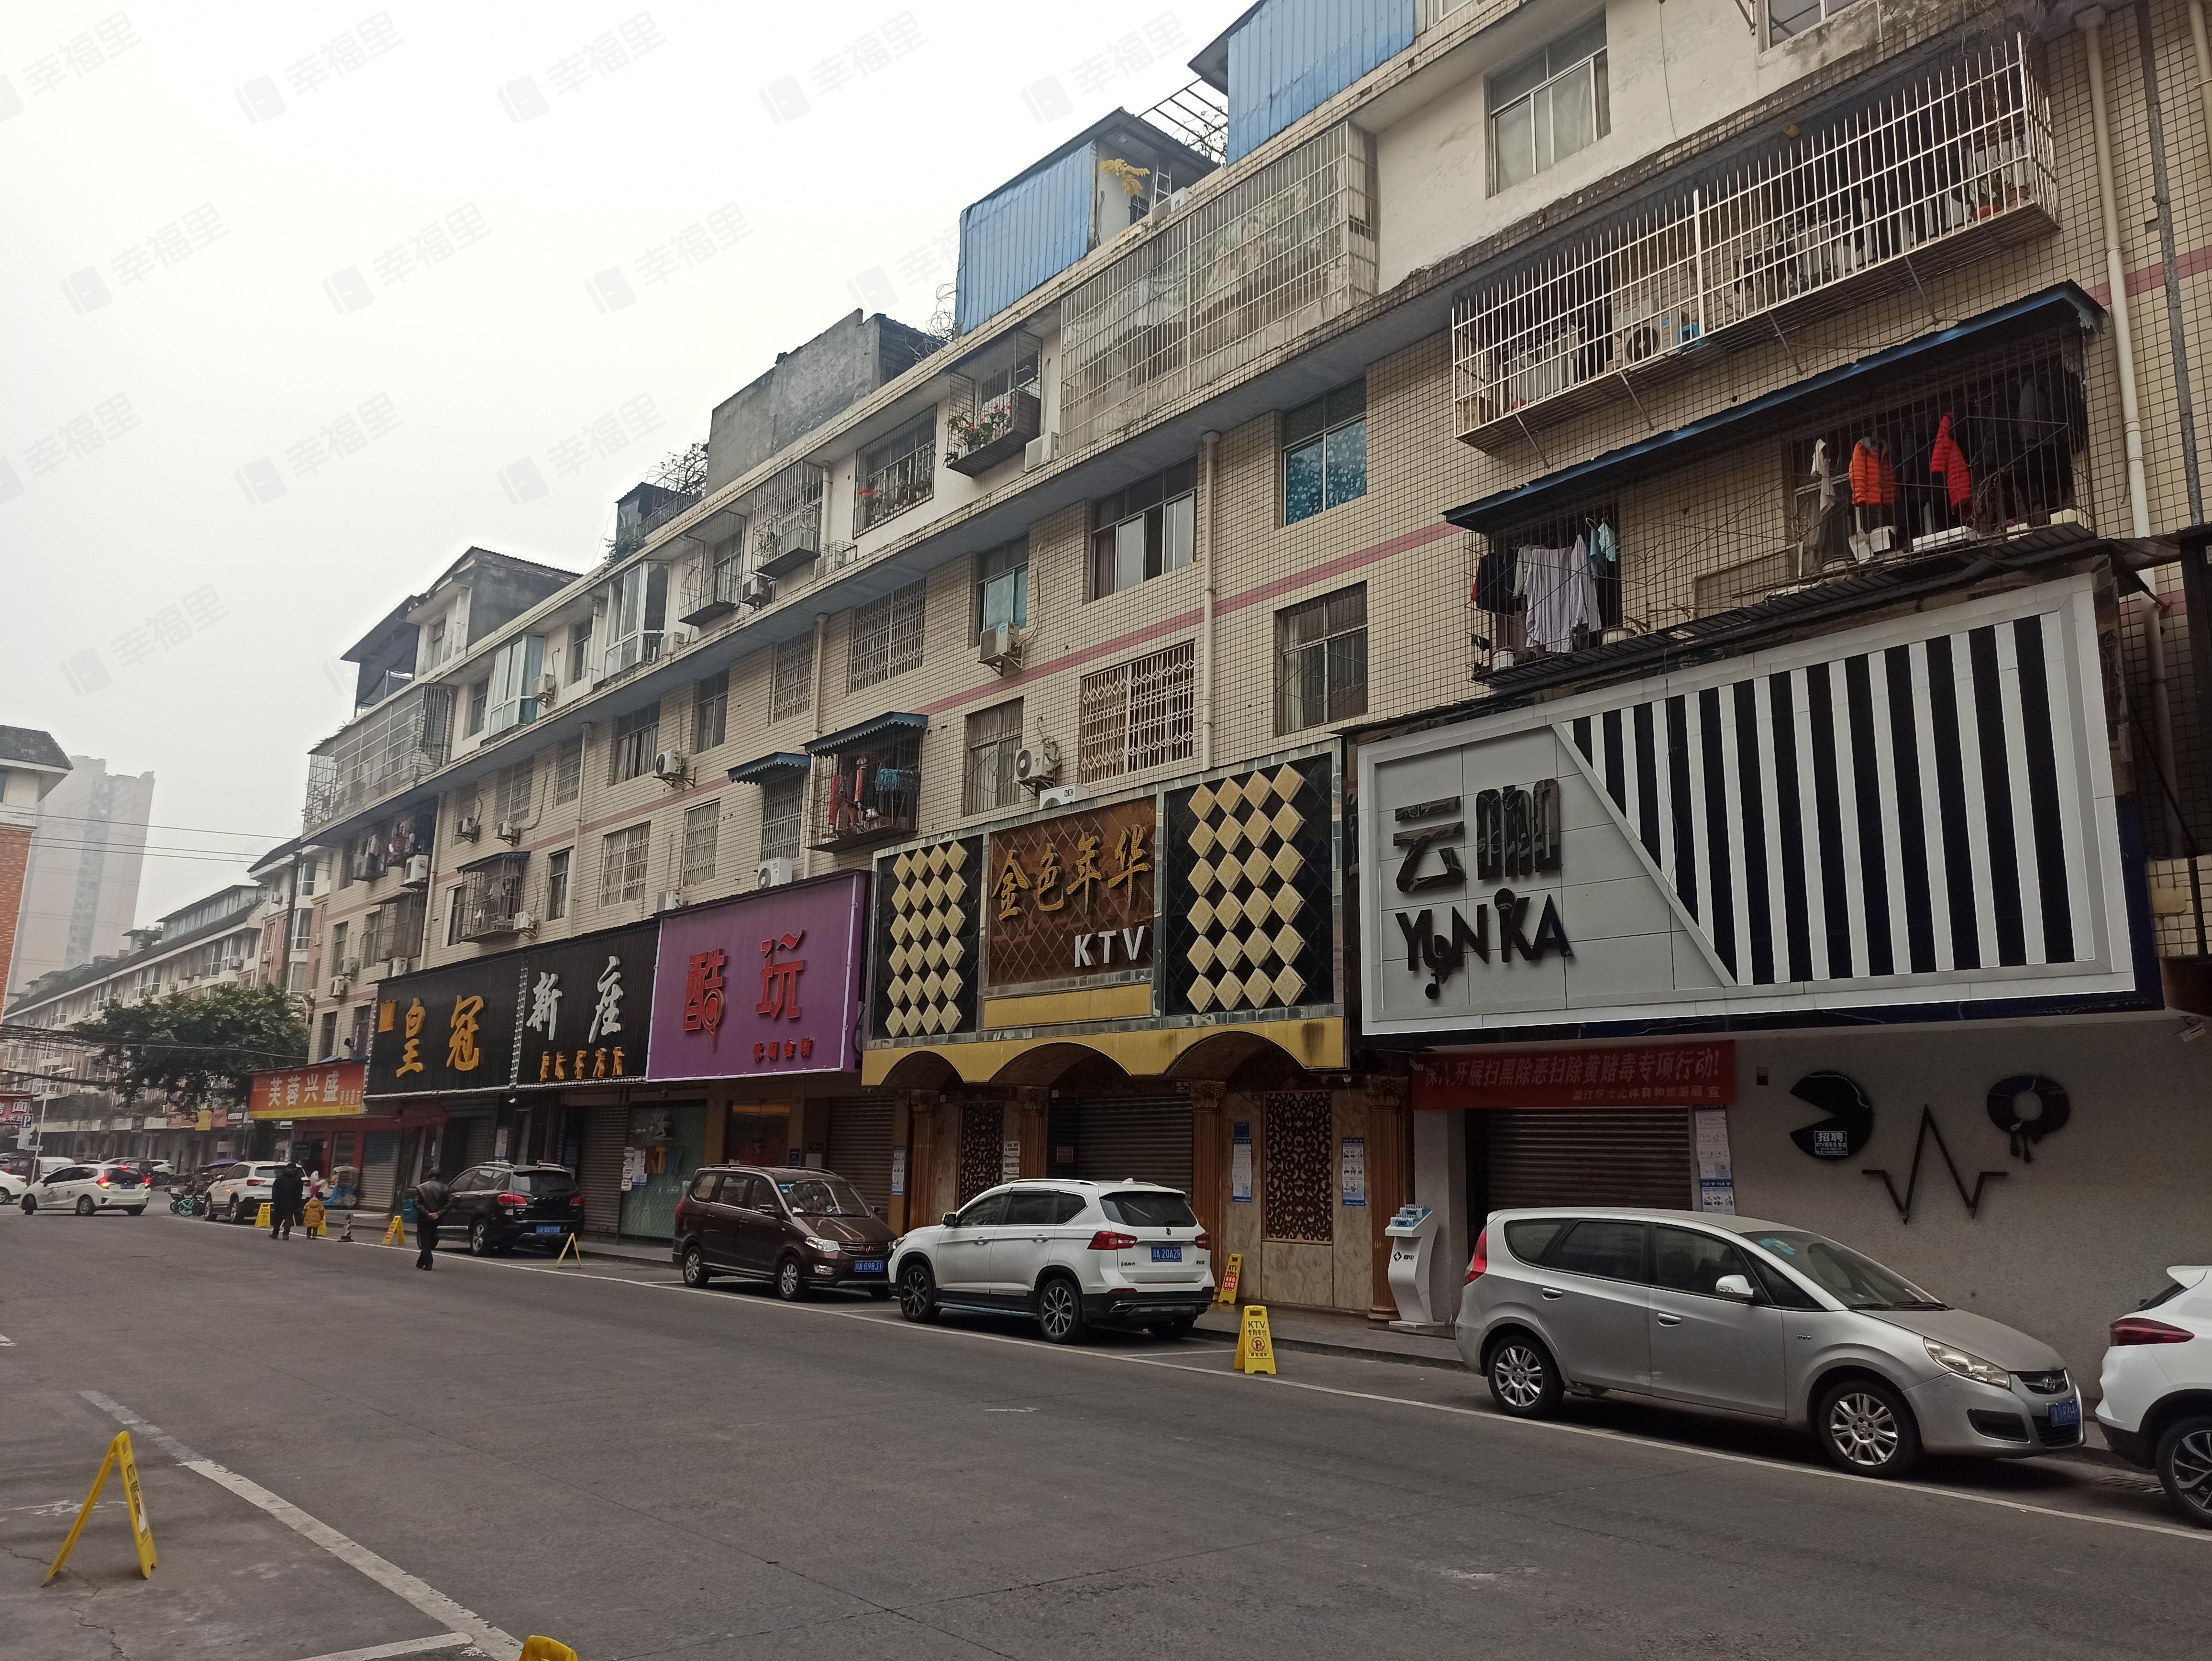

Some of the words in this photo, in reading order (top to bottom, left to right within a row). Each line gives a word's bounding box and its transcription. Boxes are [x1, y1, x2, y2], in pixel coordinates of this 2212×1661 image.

[992, 824, 1150, 921] 金色年华
[1074, 925, 1145, 968] KTV
[683, 930, 806, 1050] 酷玩
[396, 995, 484, 1078] 皇冠
[268, 1071, 339, 1107] 芙蓉兴盛
[1572, 1086, 1703, 1100] 温江区文化体育和旅游局
[1707, 1085, 1720, 1098] 宣
[1817, 1132, 1844, 1142] 招聘
[644, 1146, 683, 1174] KTV
